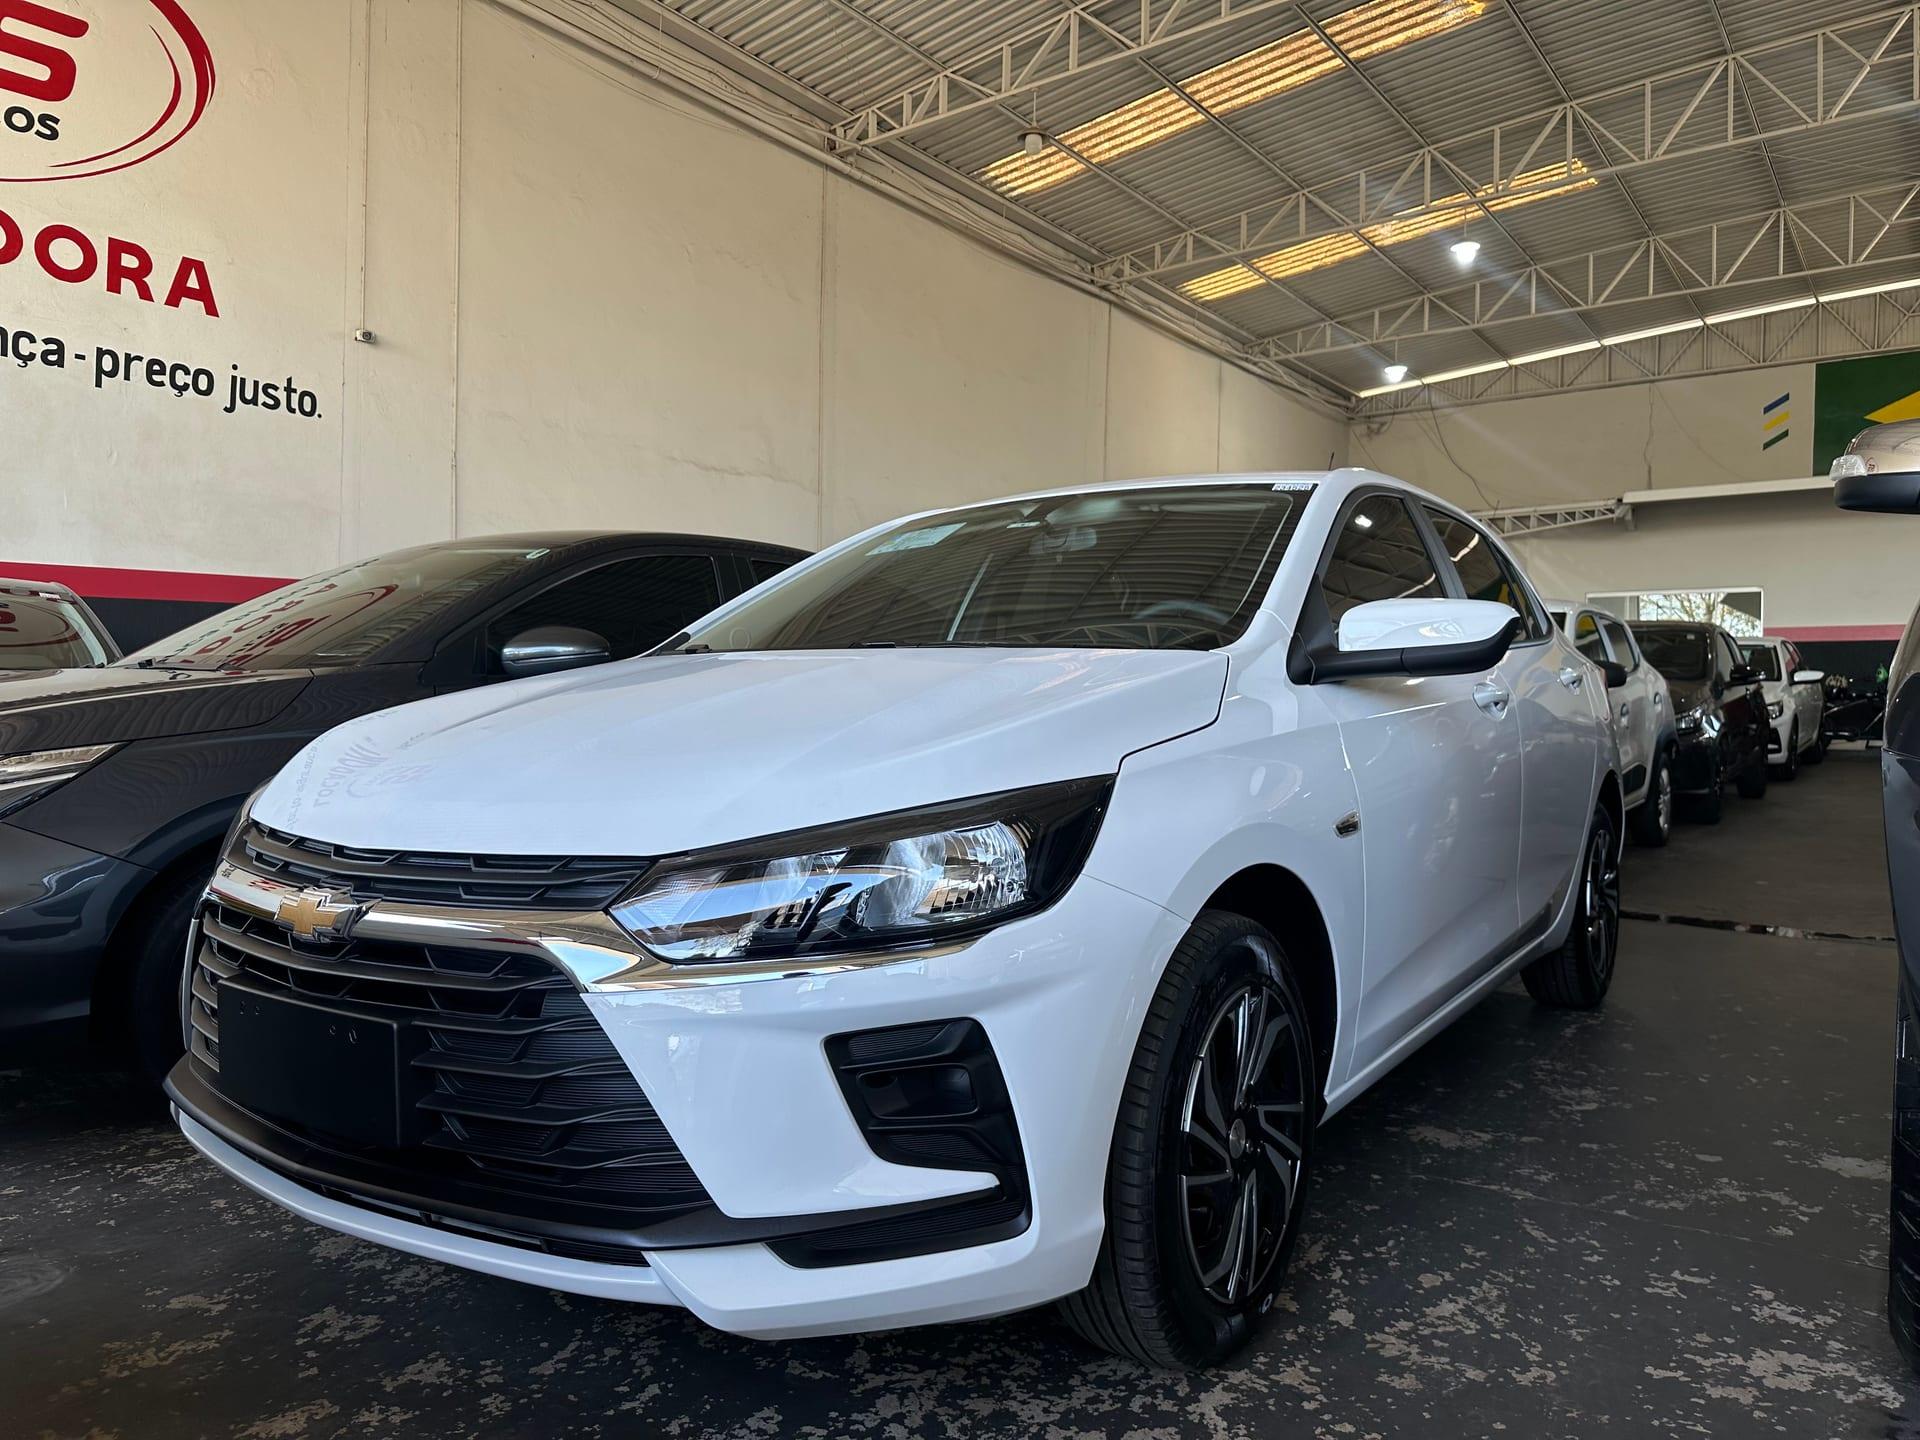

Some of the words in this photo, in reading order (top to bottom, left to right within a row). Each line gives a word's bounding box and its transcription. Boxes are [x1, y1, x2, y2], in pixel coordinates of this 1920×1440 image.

[0, 106, 60, 141] OS
[95, 346, 215, 398] preço
[223, 363, 322, 419] justo.
